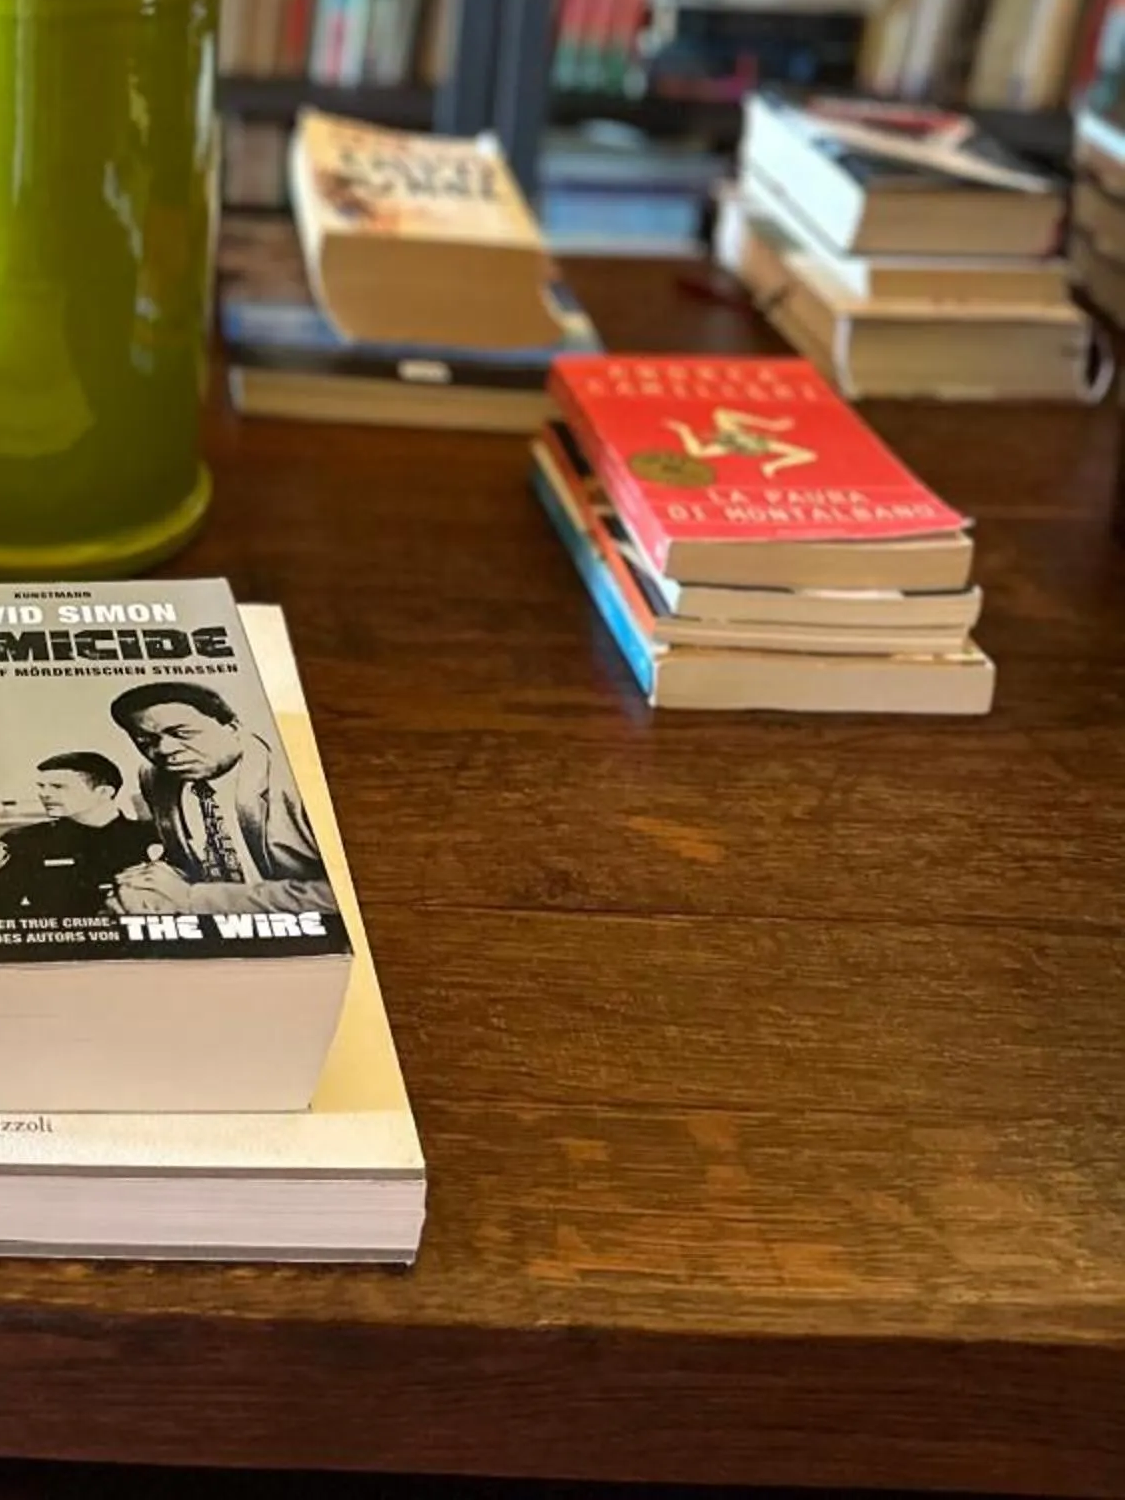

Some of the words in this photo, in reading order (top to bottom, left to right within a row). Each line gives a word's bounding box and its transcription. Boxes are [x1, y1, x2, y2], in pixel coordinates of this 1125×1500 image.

[705, 488, 751, 505] LA
[763, 488, 871, 506] PAURA
[666, 503, 706, 522] DI
[14, 590, 92, 599] KUNSTMANN
[58, 603, 177, 624] SIMON
[14, 664, 146, 677] MÖRDERISCHEN
[152, 664, 239, 676] STRASSEN
[21, 918, 58, 930] TRUE
[62, 917, 117, 929] CRIME-
[26, 931, 86, 944] AUTORS
[89, 930, 120, 942] VON
[120, 915, 203, 941] THE
[212, 911, 328, 939] WIRE
